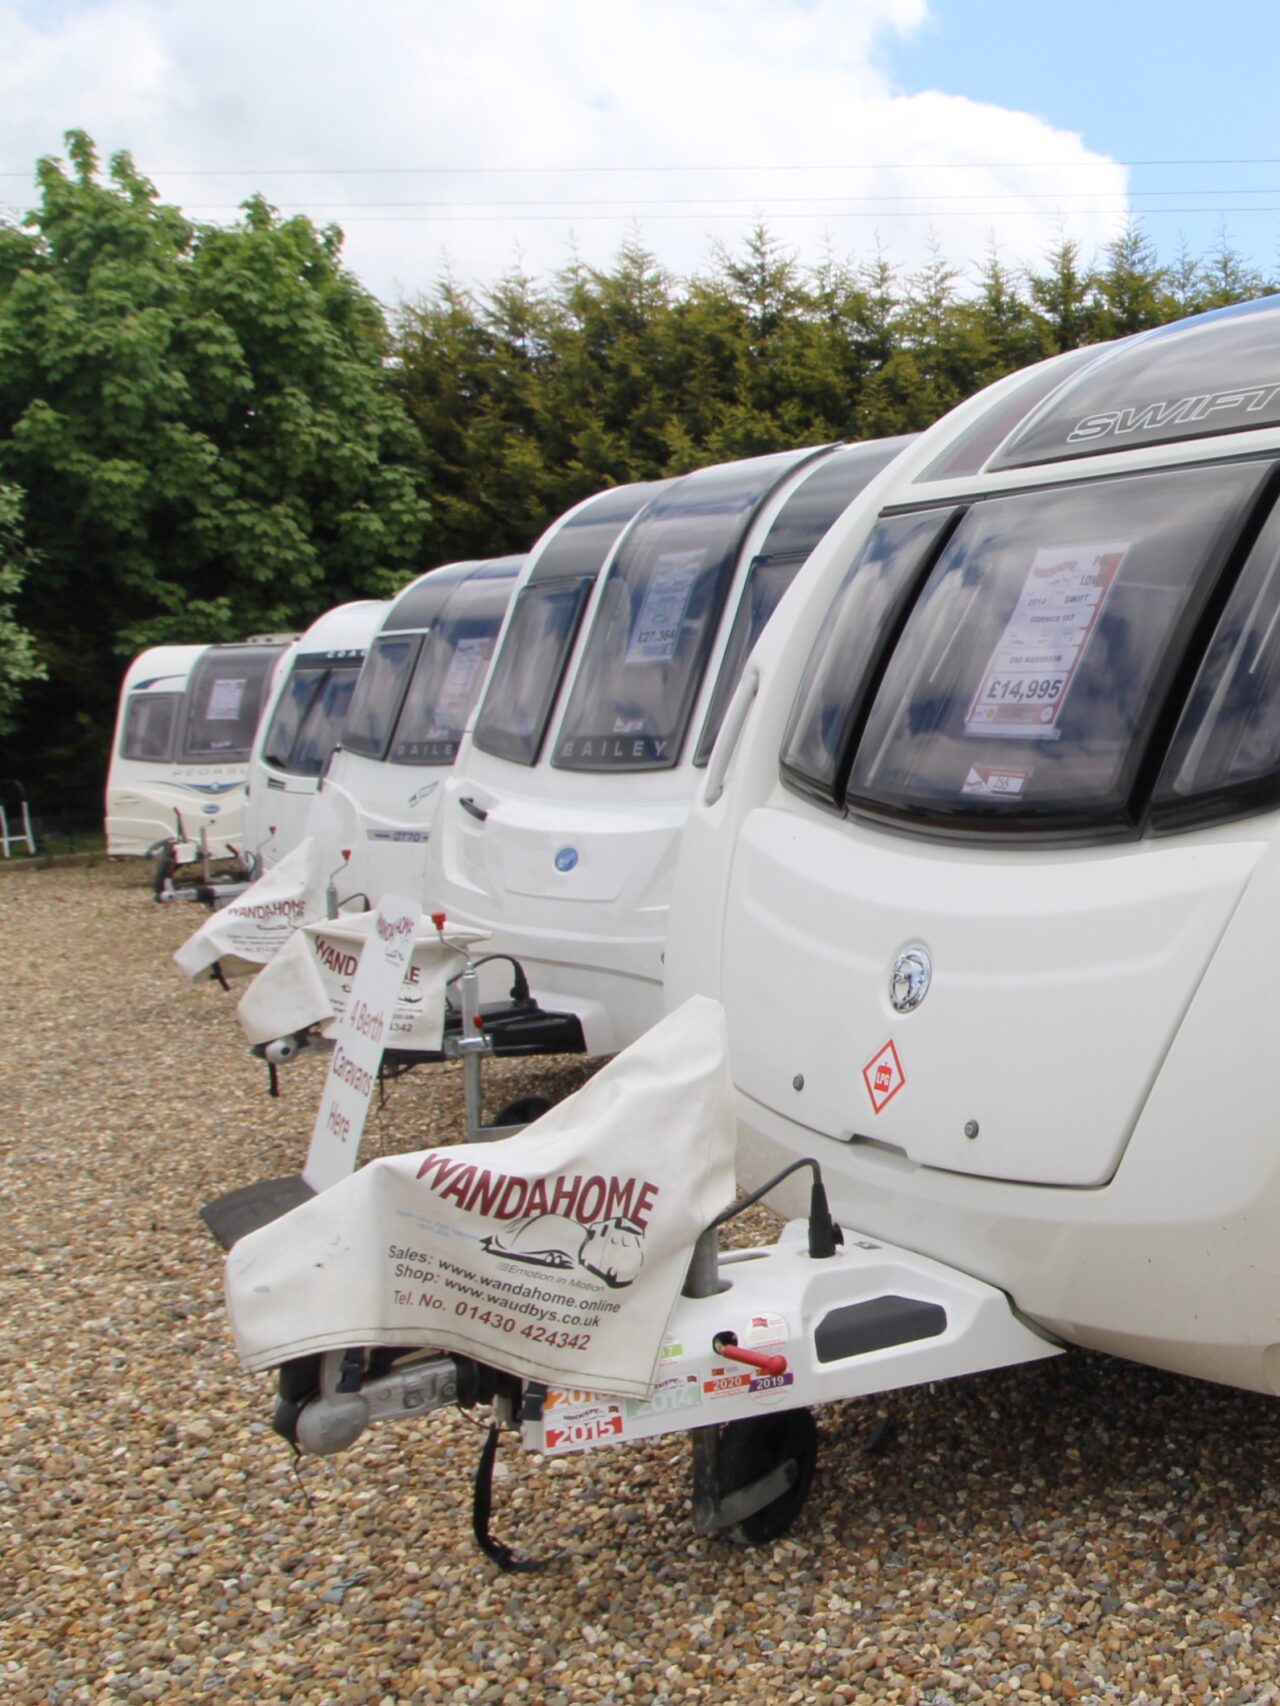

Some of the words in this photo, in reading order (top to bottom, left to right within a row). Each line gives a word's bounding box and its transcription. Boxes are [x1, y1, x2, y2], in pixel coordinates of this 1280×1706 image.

[1064, 594, 1090, 604] SWIFT
[986, 679, 1064, 703] £14,995
[561, 740, 668, 758] BAILEY
[356, 1002, 385, 1043] Berth
[332, 1046, 374, 1098] Caravans
[876, 1072, 890, 1085] LPG
[328, 1101, 350, 1143] Here
[415, 1153, 660, 1230] WANDAHOME
[388, 1244, 434, 1265] Sales:
[438, 1258, 622, 1314] www.wandahome.online
[507, 1264, 554, 1284] Emotion
[556, 1273, 567, 1286] in
[568, 1275, 606, 1294] Motion
[394, 1263, 441, 1285] Shop:
[444, 1278, 601, 1328] www.waudbys.co.uk
[393, 1289, 414, 1306] Tel.
[418, 1292, 447, 1312] No.
[454, 1301, 516, 1333] 01430
[519, 1323, 592, 1351] 424342
[712, 1376, 743, 1391] 2020
[756, 1375, 785, 1391] 2019
[553, 1419, 616, 1448] 2015
